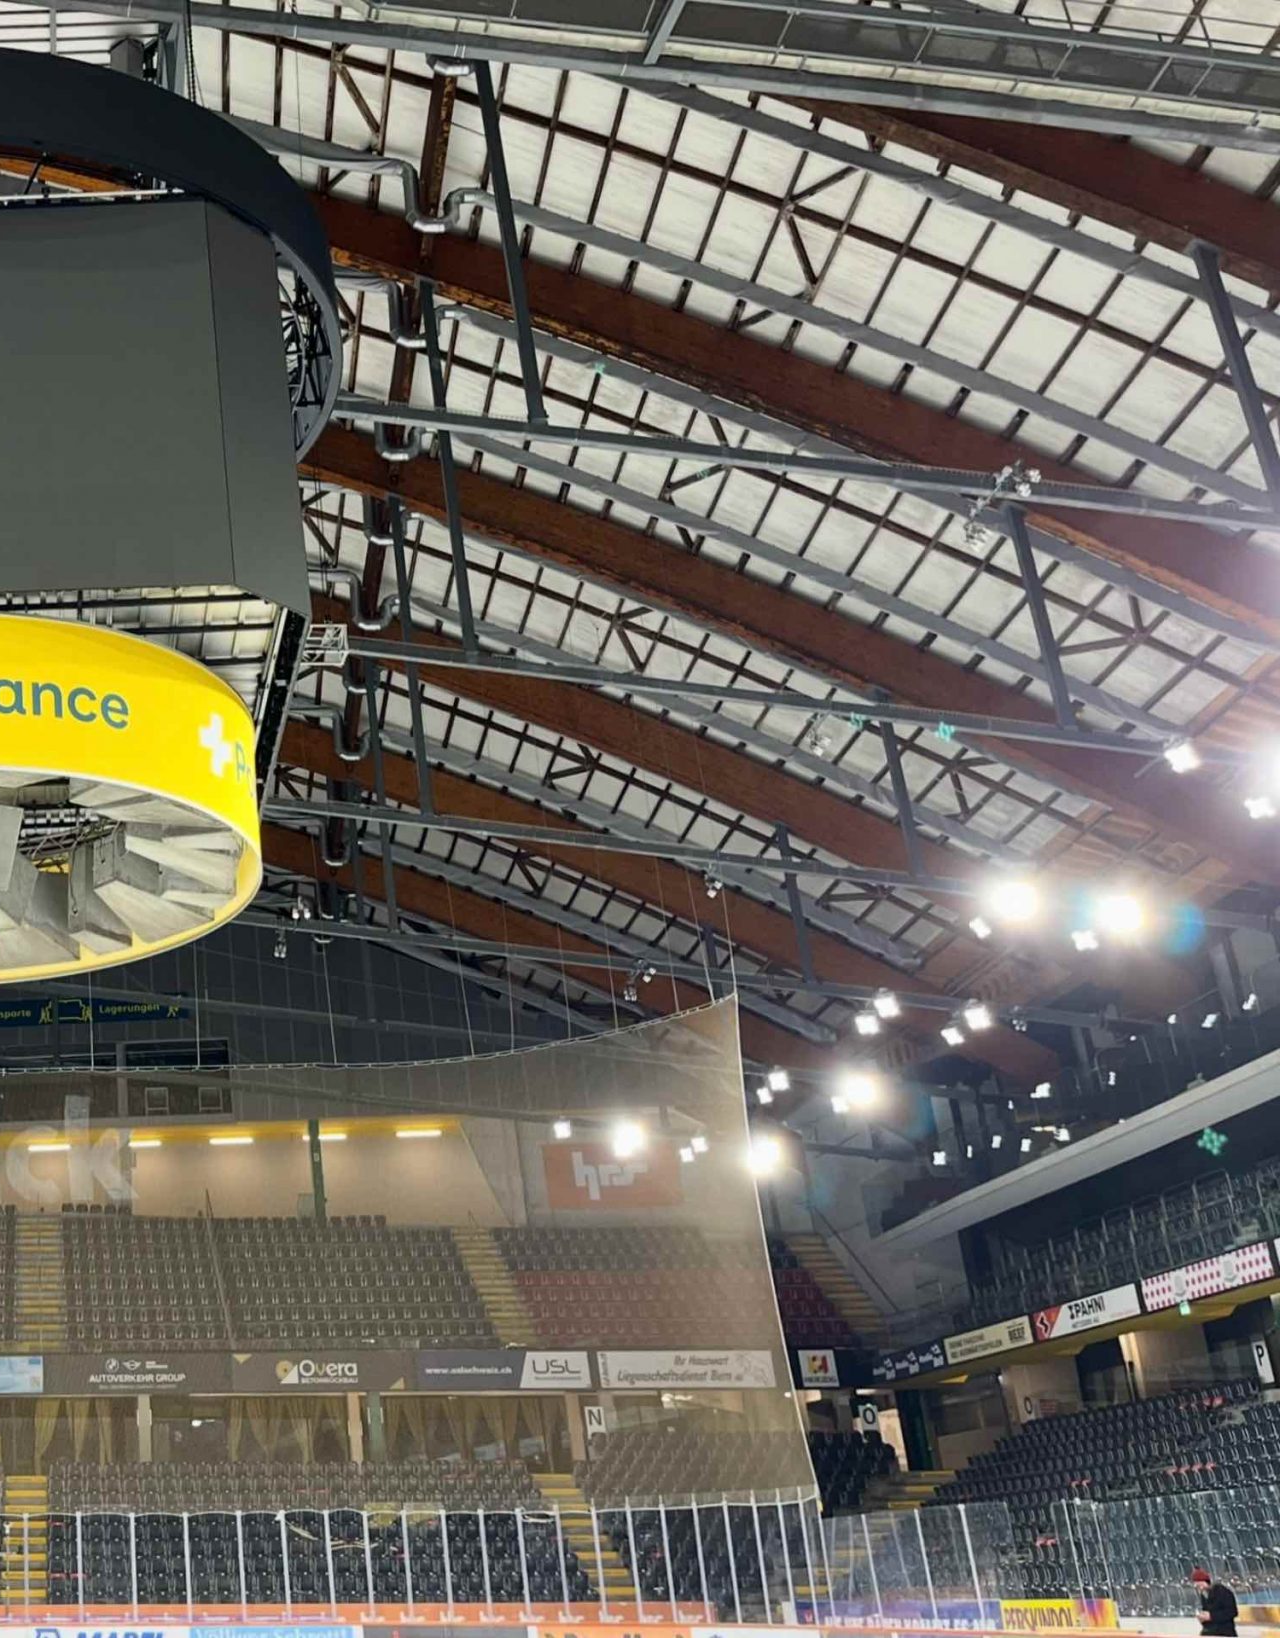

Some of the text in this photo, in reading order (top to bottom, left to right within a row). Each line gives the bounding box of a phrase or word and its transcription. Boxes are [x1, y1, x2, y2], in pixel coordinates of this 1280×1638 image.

[1256, 1345, 1265, 1367] P
[299, 1359, 358, 1378] Overa
[531, 1359, 582, 1374] USL
[156, 1372, 187, 1383] GROUP
[588, 1409, 603, 1426] N
